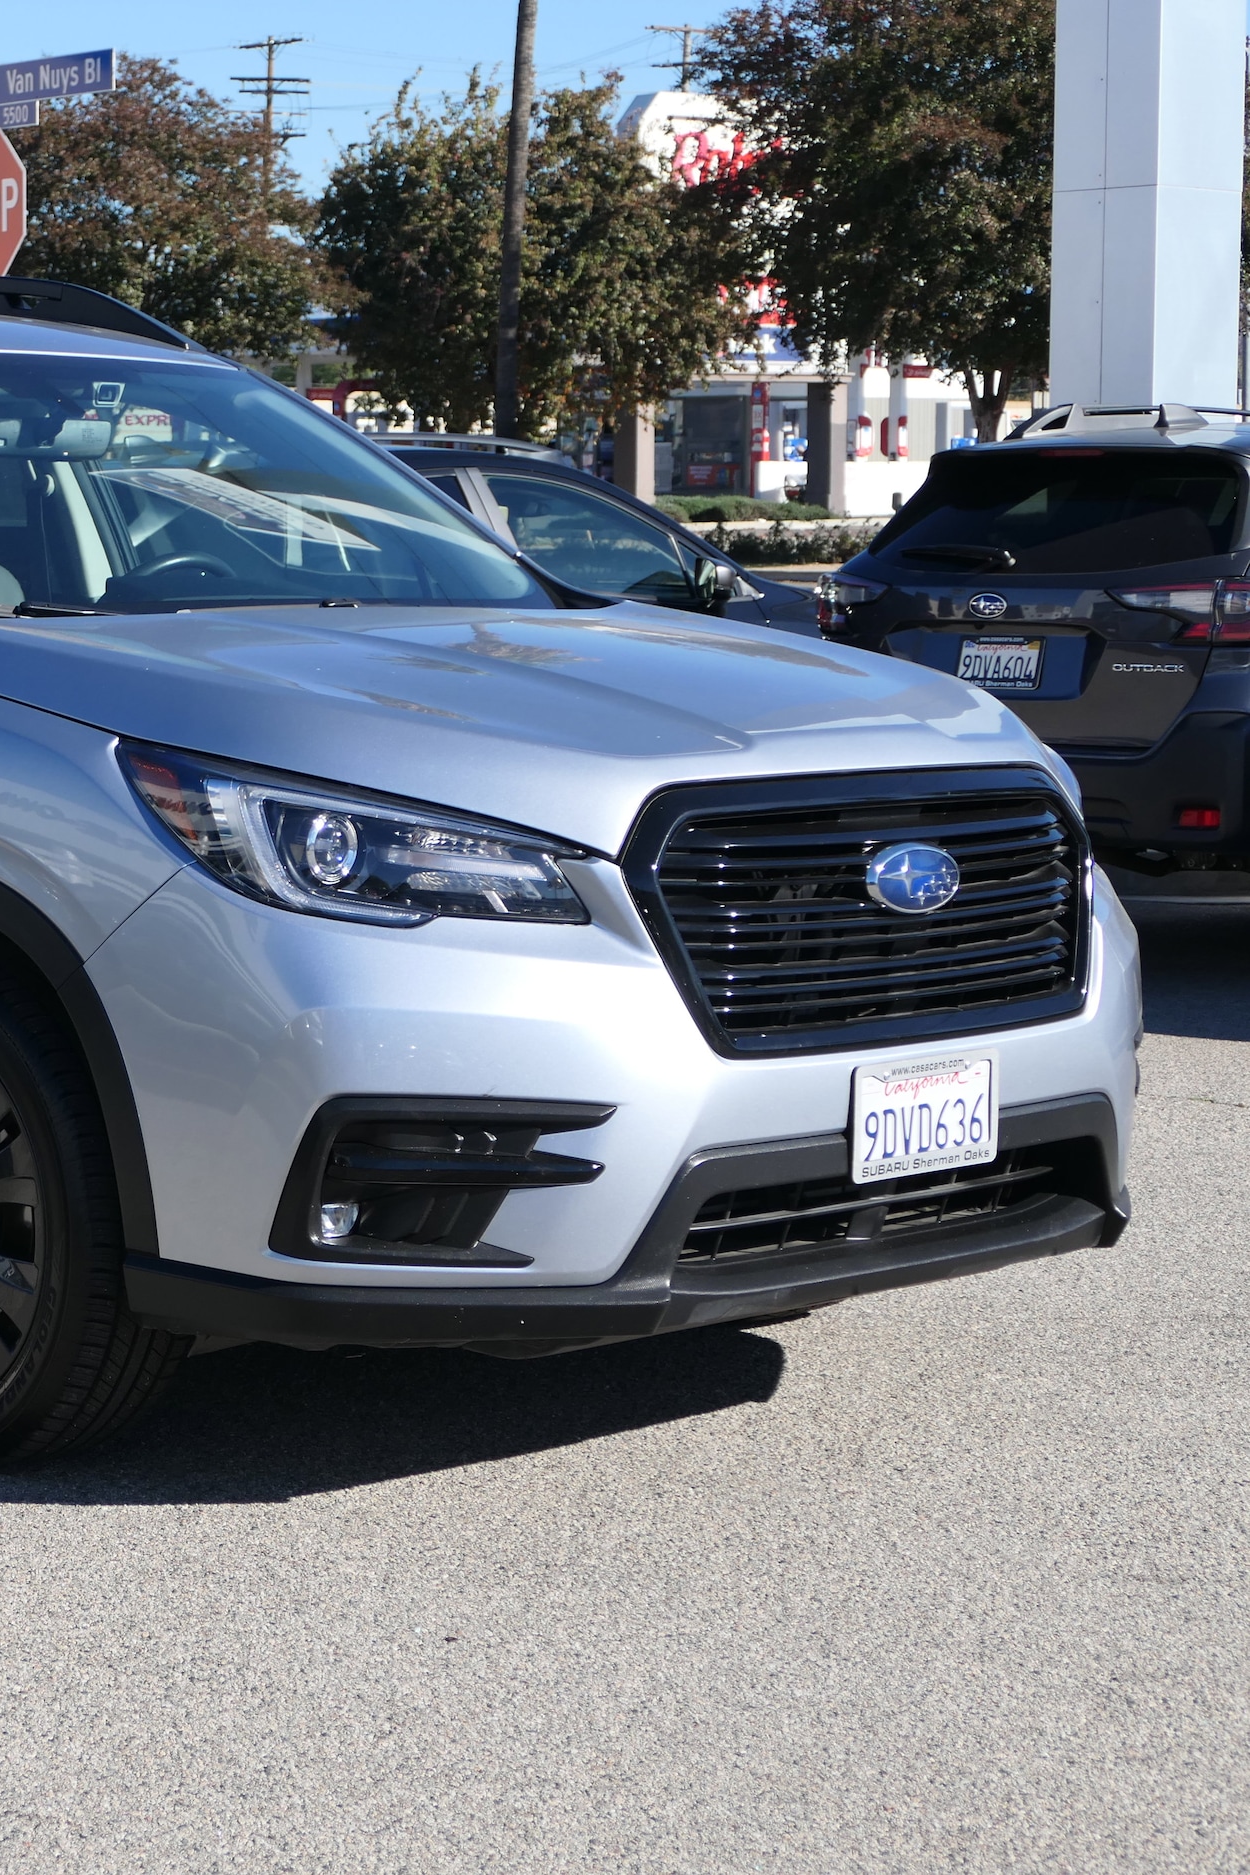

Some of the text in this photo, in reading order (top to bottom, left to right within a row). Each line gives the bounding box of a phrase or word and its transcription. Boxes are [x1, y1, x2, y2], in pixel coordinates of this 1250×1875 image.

[6, 57, 101, 95] Van Nuys Bl
[2, 105, 29, 125] 5500
[961, 654, 1033, 679] 9DVA604
[1112, 663, 1184, 673] OUTBACK
[891, 1058, 965, 1077] www.casacars.com
[883, 1071, 968, 1100] California
[864, 1093, 984, 1162] 9DVD636
[862, 1149, 990, 1178] SUBARU Sherman Oaks
